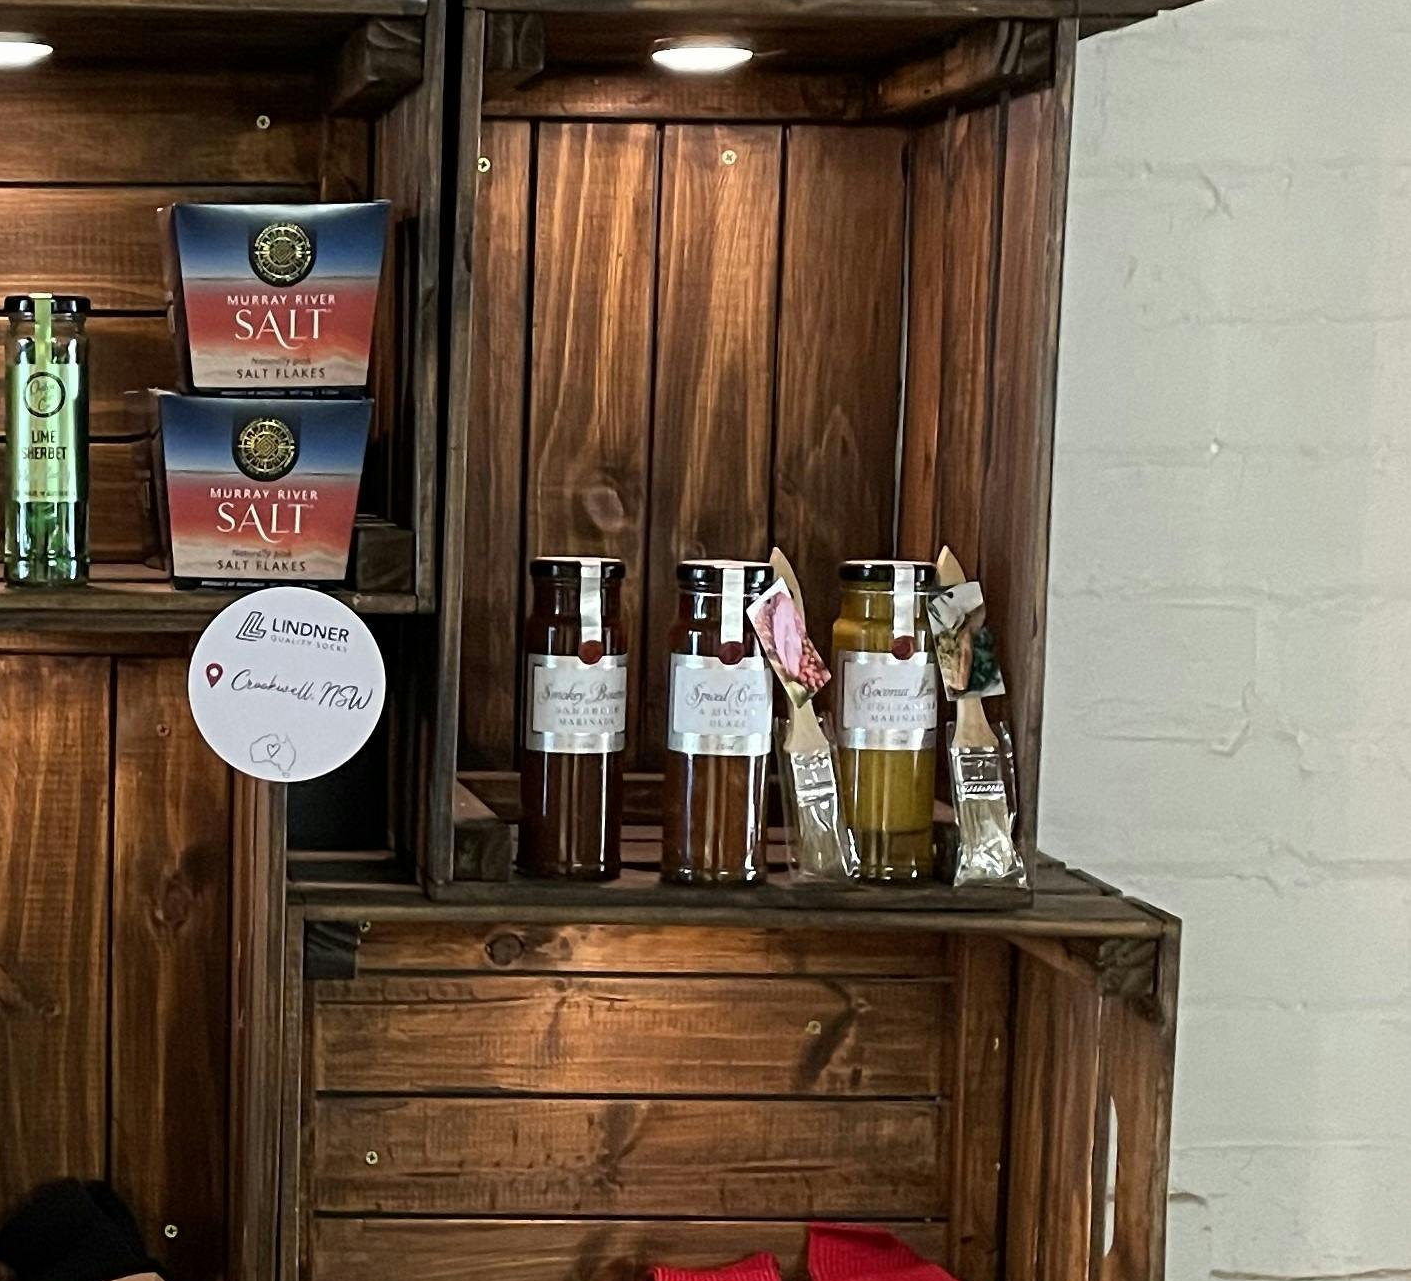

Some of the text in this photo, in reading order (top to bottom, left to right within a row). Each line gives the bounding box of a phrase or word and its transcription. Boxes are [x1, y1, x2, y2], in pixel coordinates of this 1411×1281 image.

[227, 294, 335, 305] MURRAY RIVER
[235, 308, 327, 350] SALT
[237, 367, 325, 380] SALT FLAKES
[32, 430, 55, 444] LIME
[23, 447, 67, 461] SHERBET
[210, 487, 318, 501] MURRAY RIVER
[216, 502, 310, 543] SALT
[218, 559, 306, 572] SALT FLAKES
[272, 617, 349, 643] LINDNER
[271, 635, 347, 653] QUALITY SOCKS
[319, 682, 373, 710] NSW
